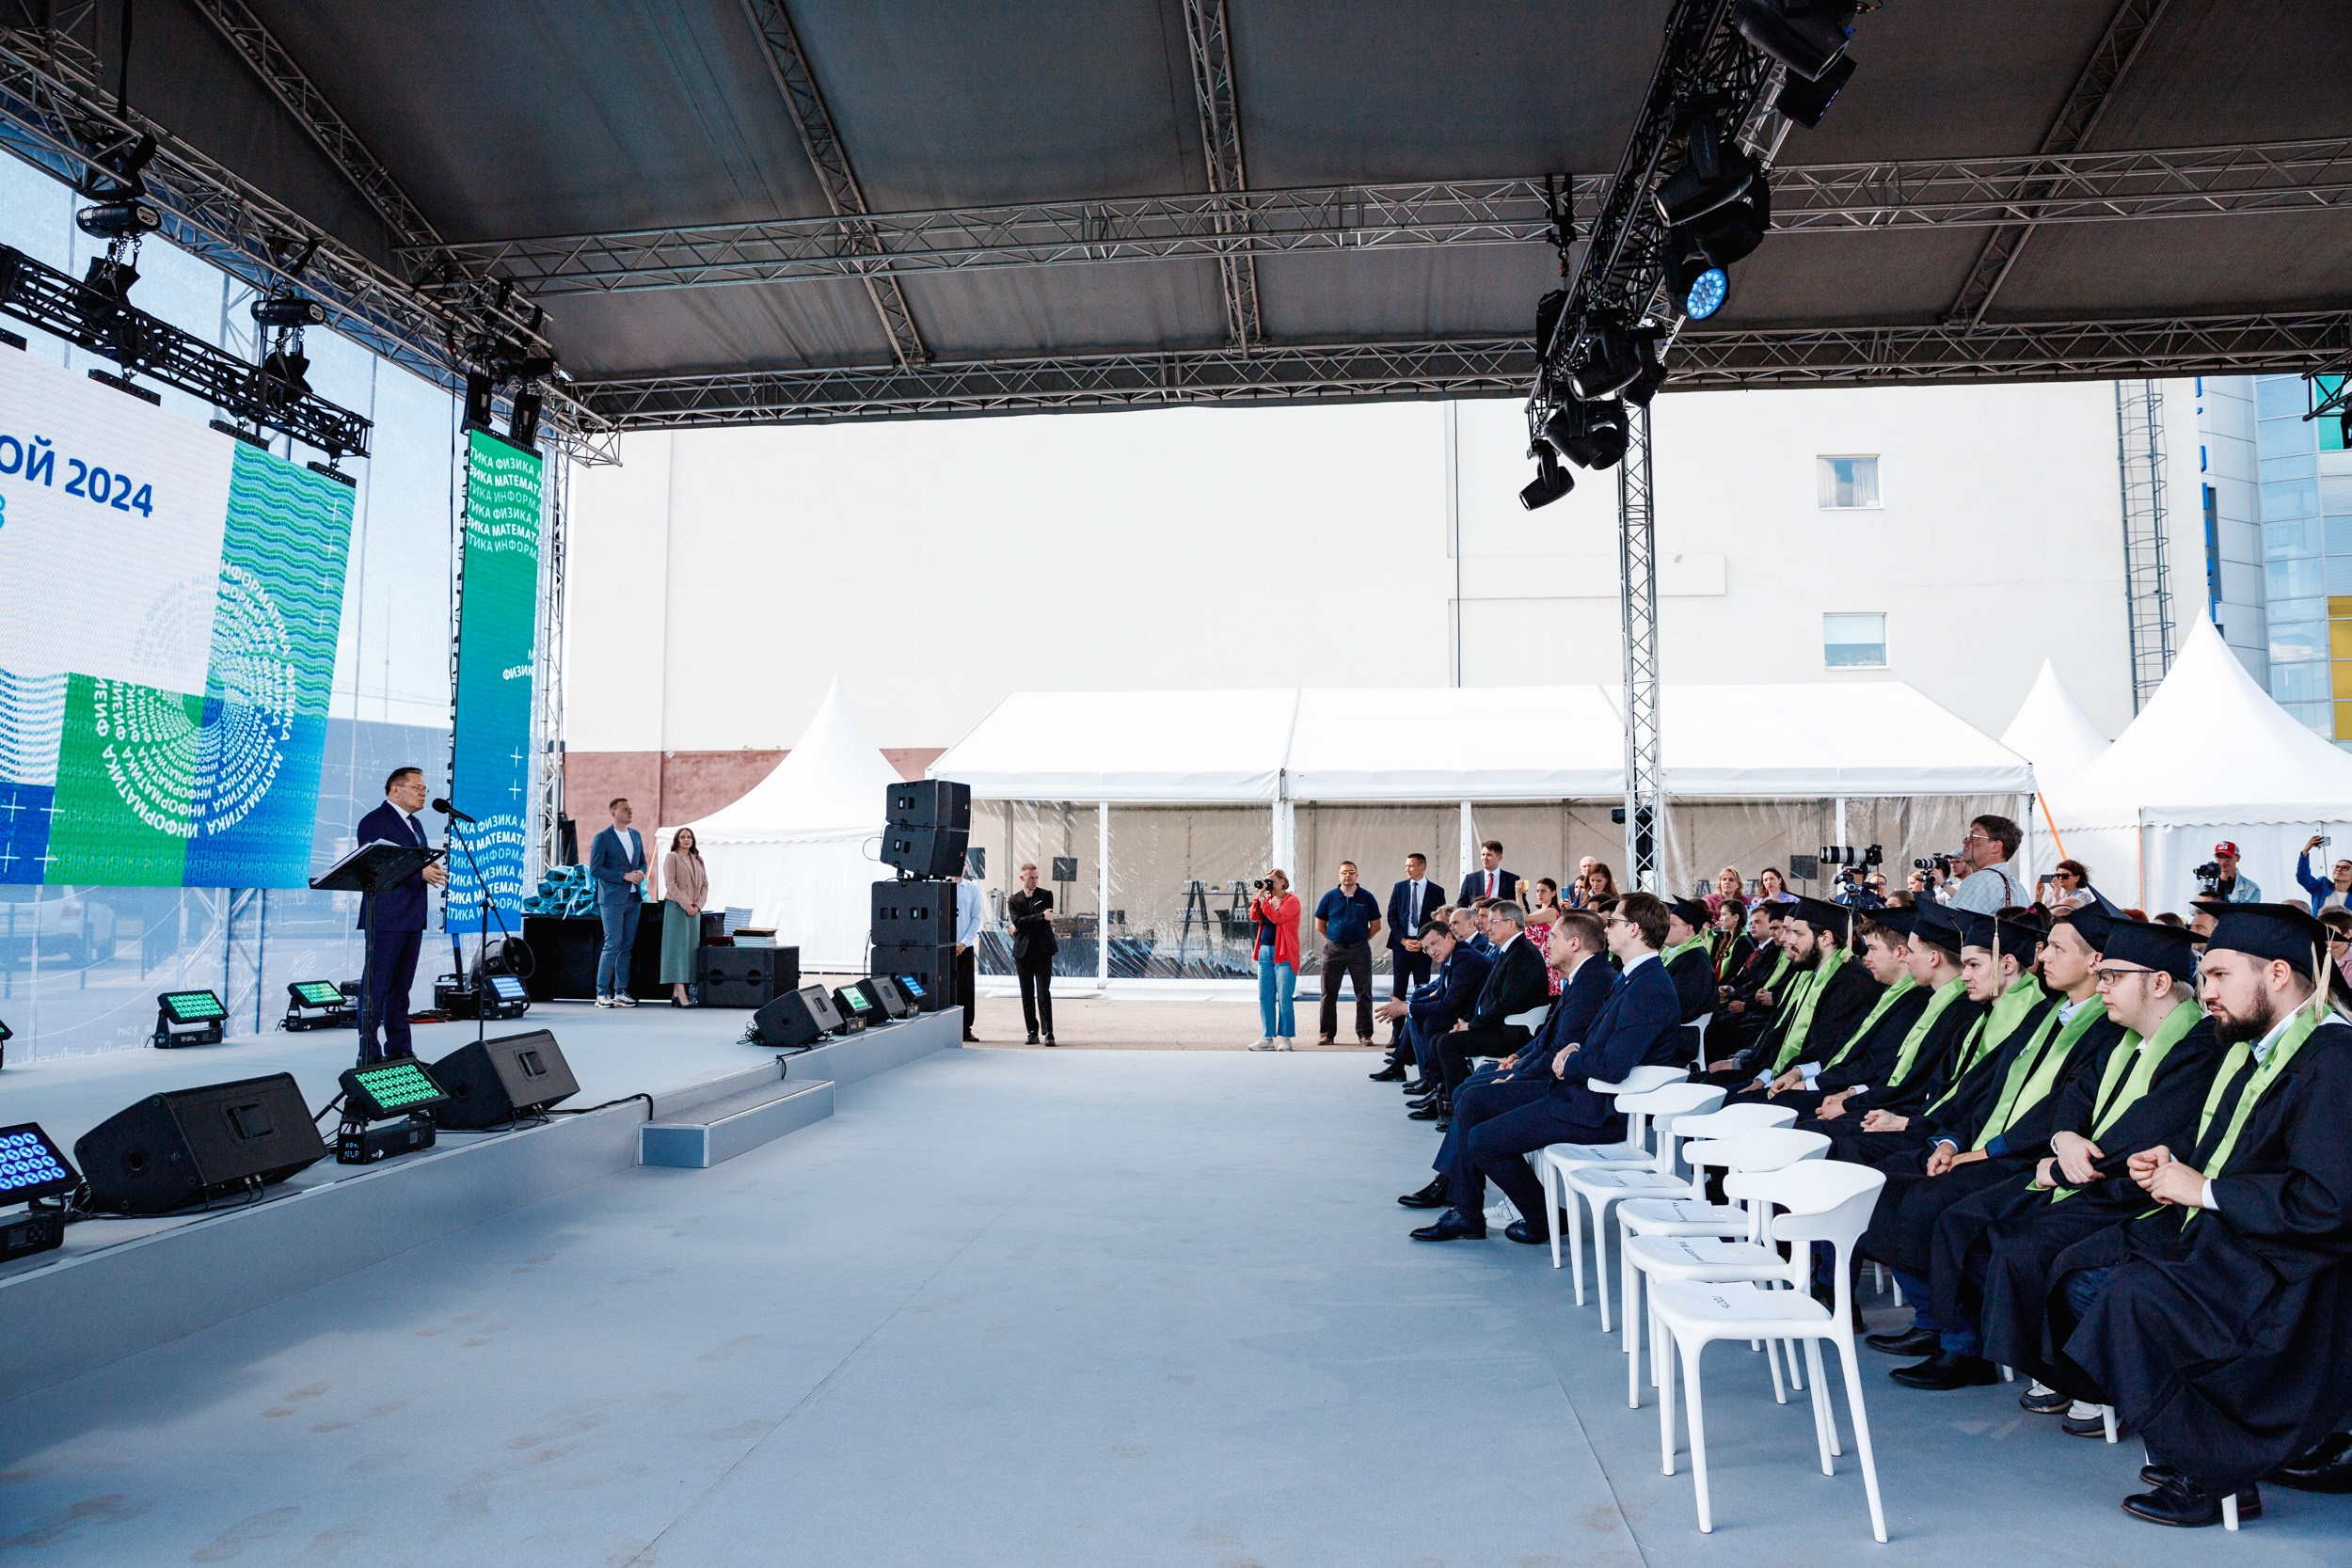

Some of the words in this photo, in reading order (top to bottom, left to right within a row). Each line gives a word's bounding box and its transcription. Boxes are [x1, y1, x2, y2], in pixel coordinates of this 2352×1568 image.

[0, 435, 55, 487] ОЙ
[65, 458, 153, 518] 2024
[469, 463, 493, 486] ЗИКА
[470, 445, 494, 468] ТИКА
[496, 458, 534, 476] ФИЗИКА
[469, 480, 492, 503] ТИКА
[466, 514, 490, 536] ЗИКА
[467, 497, 491, 519] ТИКА
[493, 507, 532, 525] ФИЗИКА
[502, 659, 532, 680] ФИЗИК
[272, 659, 282, 725] ФИЗИКА
[280, 663, 295, 740] ФИЗИКА
[137, 746, 212, 800] ИНФОРМАТИКА
[151, 744, 215, 786] ИНФОРМАТИКА
[213, 736, 276, 813] МАТЕМАТИКА
[217, 723, 268, 794] МАТЕМАТИКА
[102, 744, 198, 838] ИНФОРМАТИКА
[121, 745, 206, 816] ИНФОРМАТИКА
[207, 751, 283, 835] МАТЕМАТИКА
[477, 815, 517, 832] ФИЗИКА
[448, 871, 472, 887] ТИКА
[450, 853, 473, 869] ТИКА
[447, 890, 471, 904] ЗИКА
